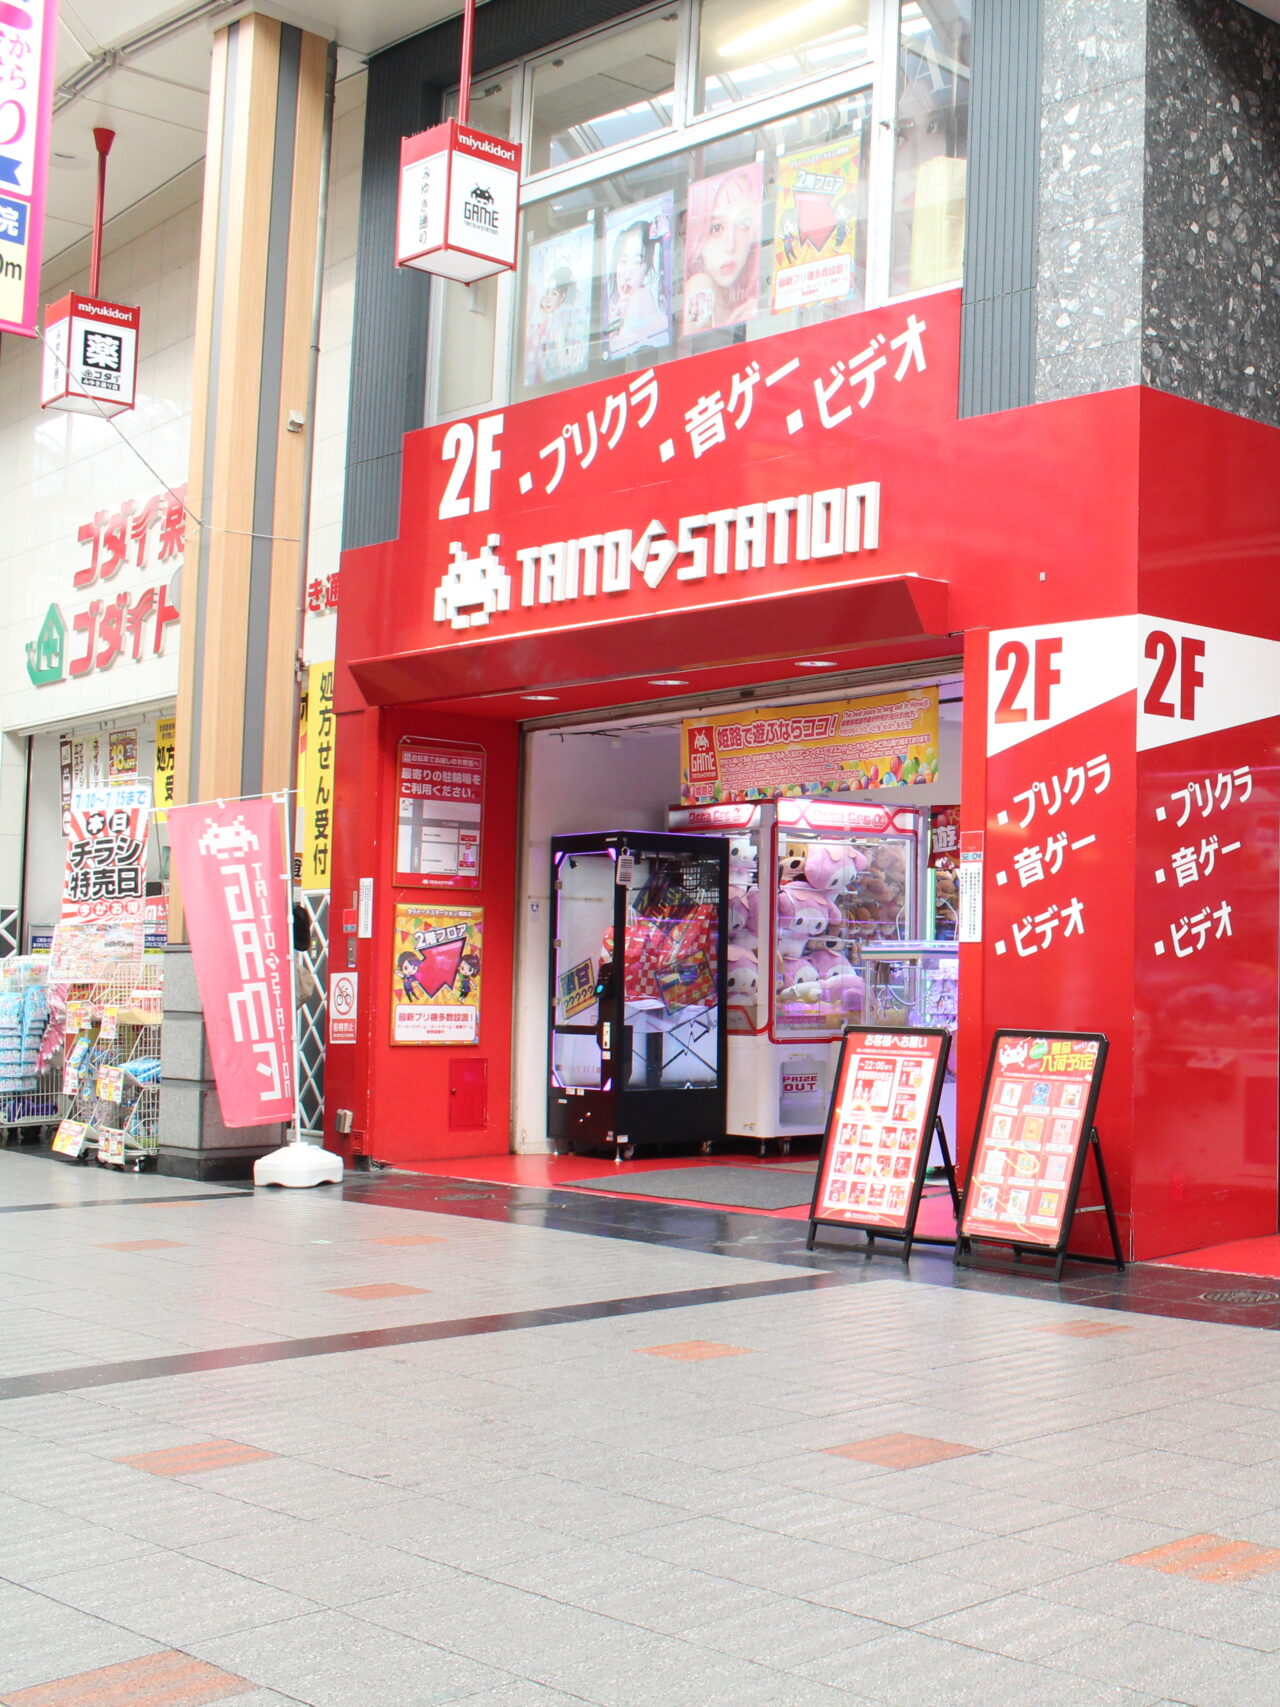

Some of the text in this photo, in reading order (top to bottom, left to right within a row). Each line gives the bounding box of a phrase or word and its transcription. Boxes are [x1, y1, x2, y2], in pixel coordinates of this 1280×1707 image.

[459, 135, 515, 161] miyukidori
[464, 201, 499, 229] GAME
[0, 256, 22, 280] m
[78, 303, 133, 321] miyukidori
[86, 334, 120, 370] 薬
[813, 314, 926, 429] ビデオ
[684, 357, 799, 458] 音ゲー
[539, 368, 660, 494] プリクラ
[438, 413, 504, 520] 2F
[994, 637, 1063, 724] 2F
[1143, 630, 1206, 721] 2F
[312, 671, 334, 876] 処方せん受付
[401, 767, 481, 785] 最寄りの駐輪場を
[691, 752, 716, 772] GAME
[401, 782, 476, 799] ご利用ください。
[1012, 753, 1112, 829] プリクラ
[1170, 765, 1252, 828] プリクラ
[87, 812, 130, 834] 本日
[71, 838, 142, 868] チラシ
[961, 853, 982, 861] SEOM
[1013, 830, 1096, 888] 音ゲー
[1171, 834, 1241, 887] 音ゲー
[70, 867, 141, 899] 特売日
[79, 902, 139, 917] 今がお得
[415, 923, 468, 947] 2階フロア
[1011, 897, 1085, 957] ビデオ
[1170, 900, 1232, 958] ビデオ
[864, 1034, 928, 1048] お客様へお願い
[1040, 1054, 1094, 1072] 入荷予定
[783, 1083, 816, 1092] OUT
